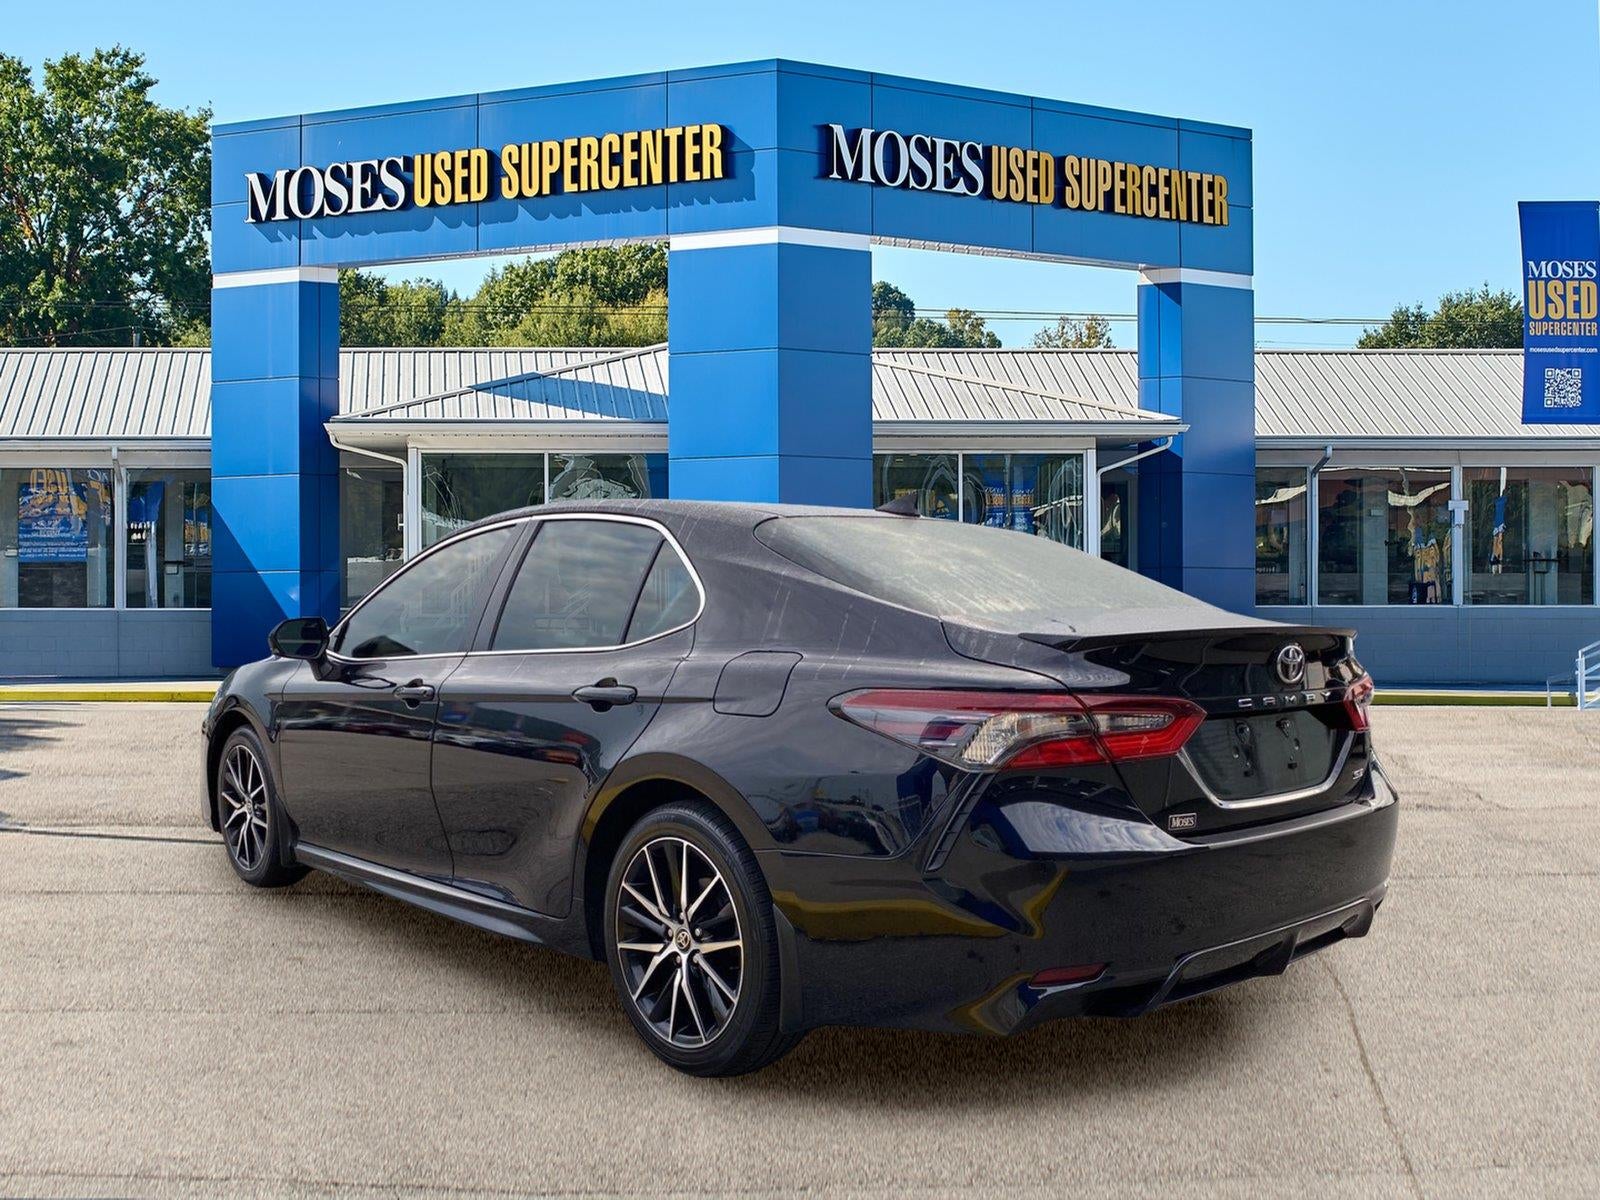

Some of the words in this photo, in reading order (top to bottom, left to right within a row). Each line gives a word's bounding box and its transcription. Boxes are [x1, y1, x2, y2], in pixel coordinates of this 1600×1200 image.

[243, 156, 406, 223] MOSES
[413, 148, 489, 208] USED
[500, 123, 724, 200] SUPERCENTER
[827, 123, 984, 197] MOSES
[991, 144, 1056, 205] USED
[1064, 154, 1230, 226] SUPERCENTER
[1527, 260, 1597, 279] MOSES
[1528, 280, 1598, 320] USED
[1529, 321, 1598, 337] SUPERCENTER
[1237, 690, 1332, 708] CAMRY
